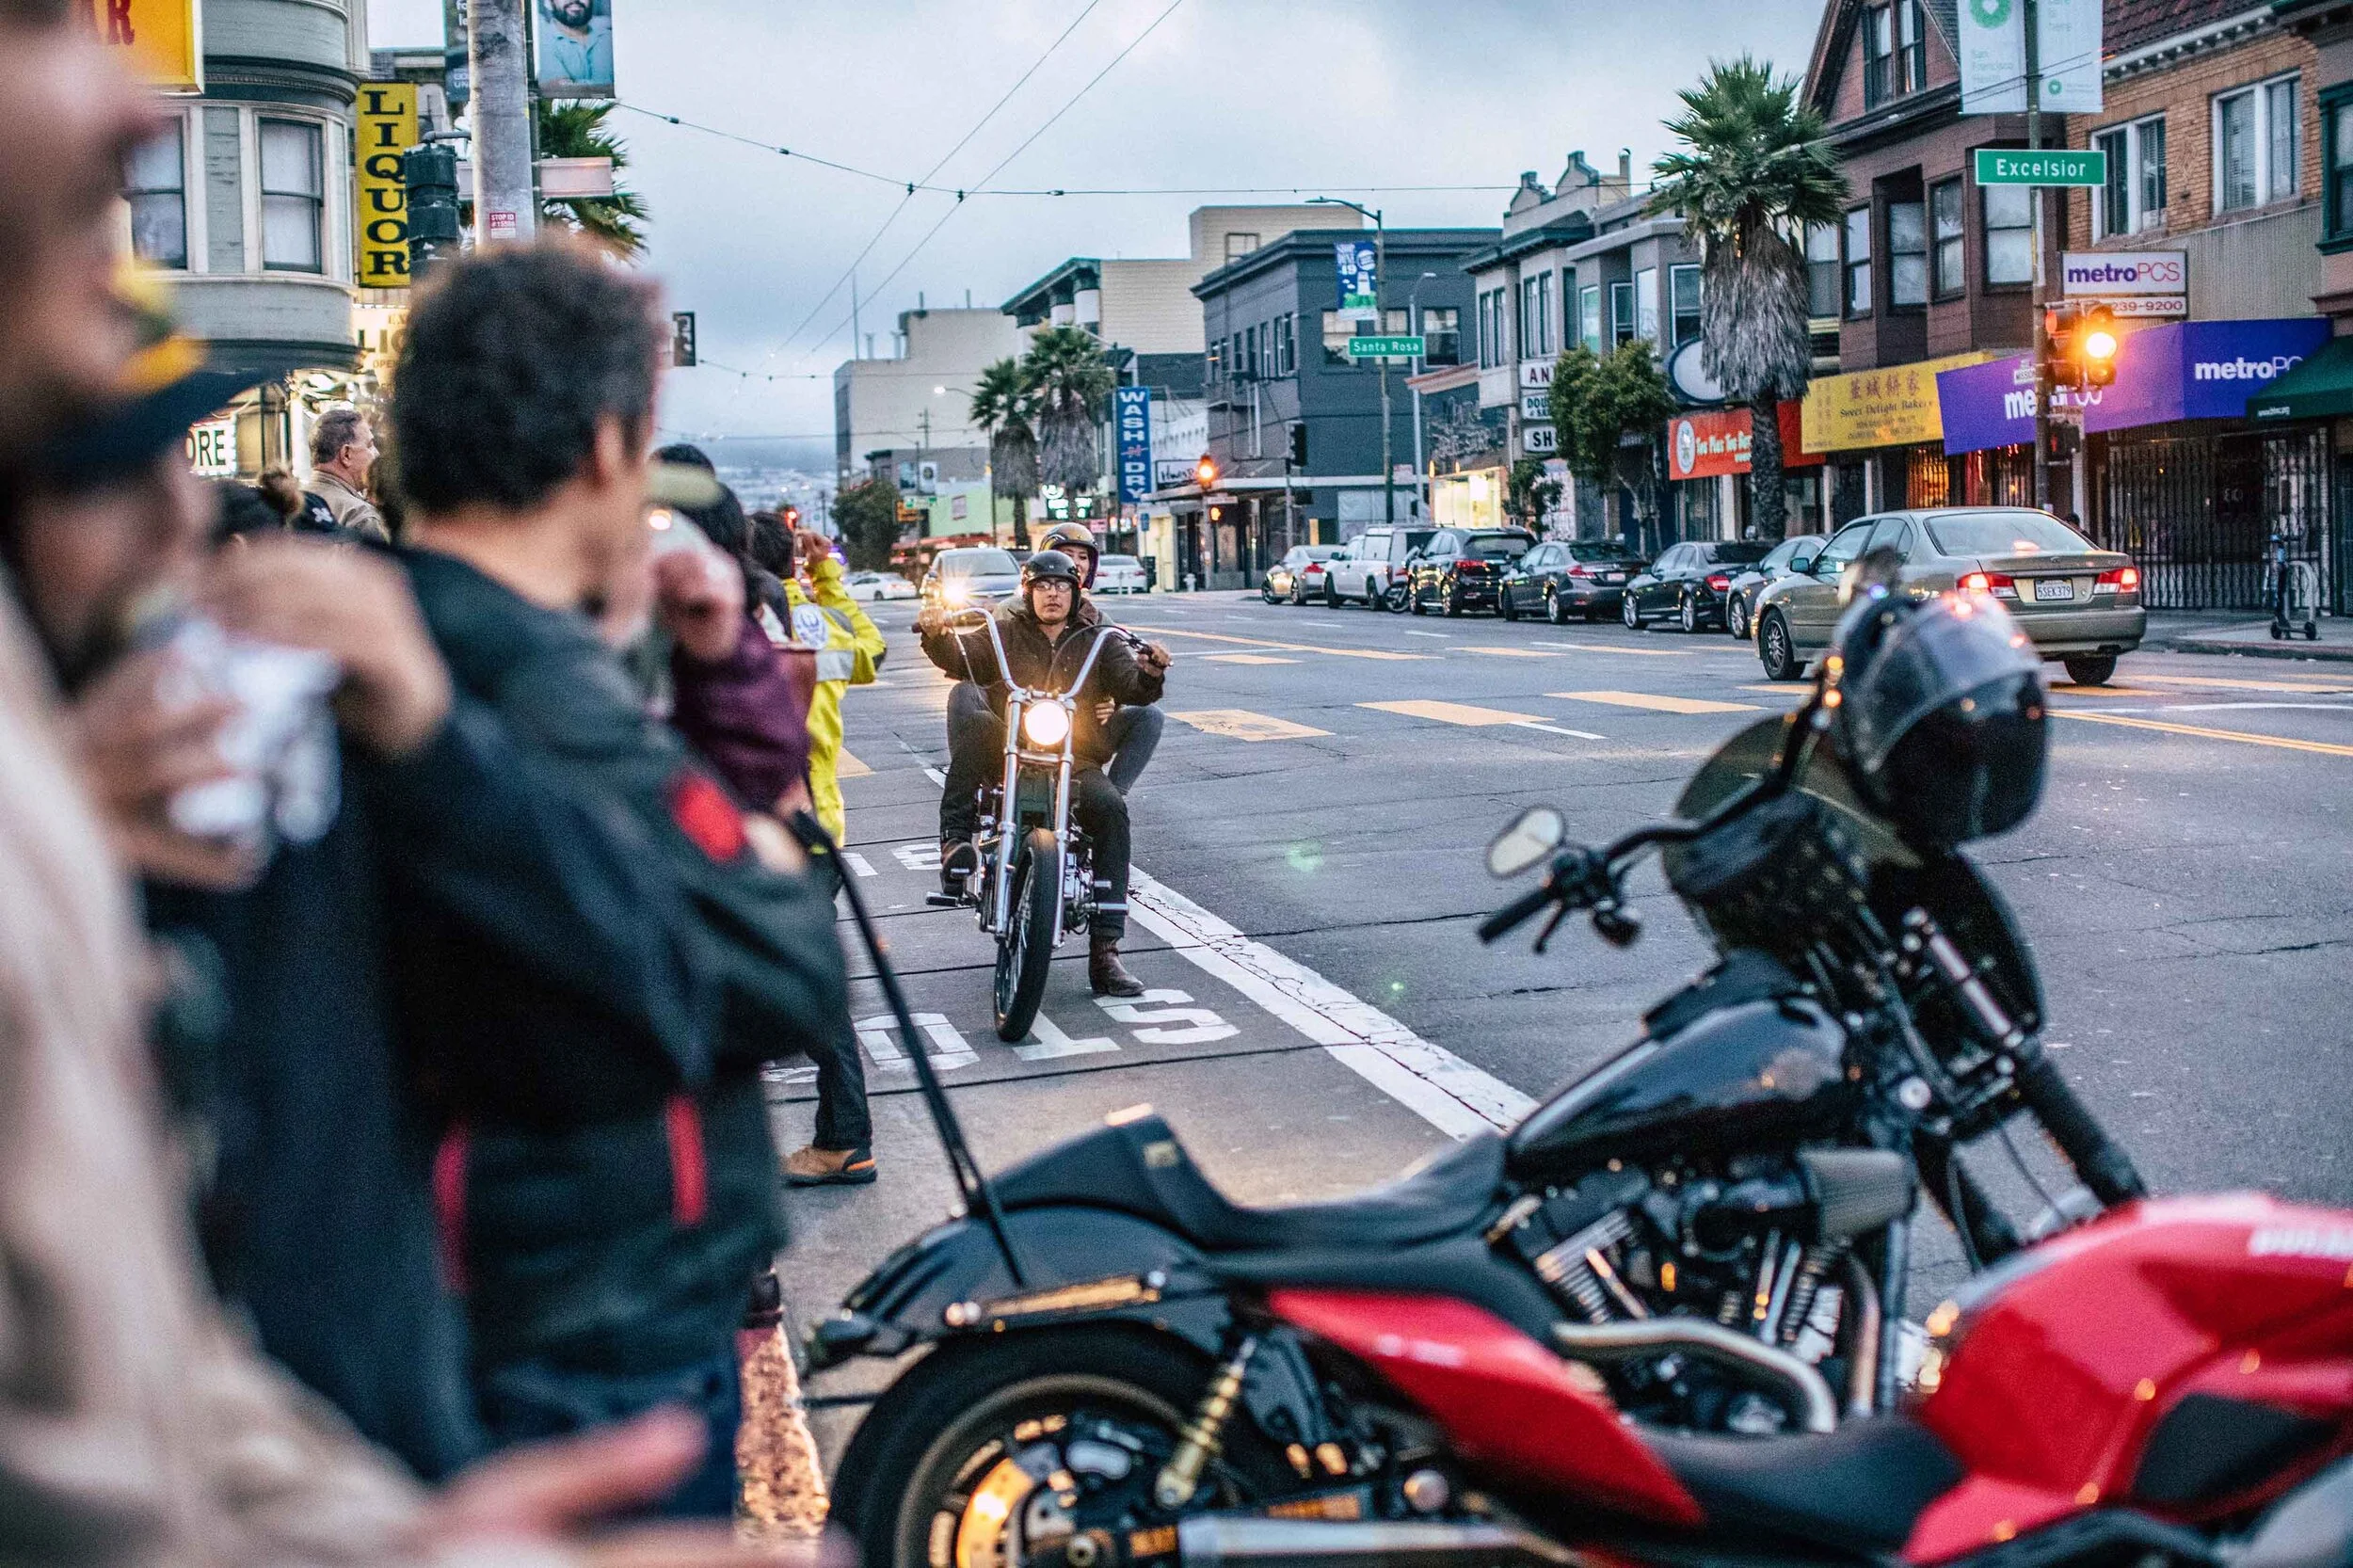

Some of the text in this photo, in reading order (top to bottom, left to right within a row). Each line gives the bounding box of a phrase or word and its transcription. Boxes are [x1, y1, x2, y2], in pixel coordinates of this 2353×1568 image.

[1996, 158, 2086, 177] Excelsior
[362, 91, 410, 275] LIQUOR
[2068, 263, 2181, 282] metroPCS
[1353, 342, 1419, 352] Santa Rosa
[1120, 392, 1145, 441] WASH
[1124, 462, 1147, 499] DRY
[2037, 585, 2072, 598] 5SEK379
